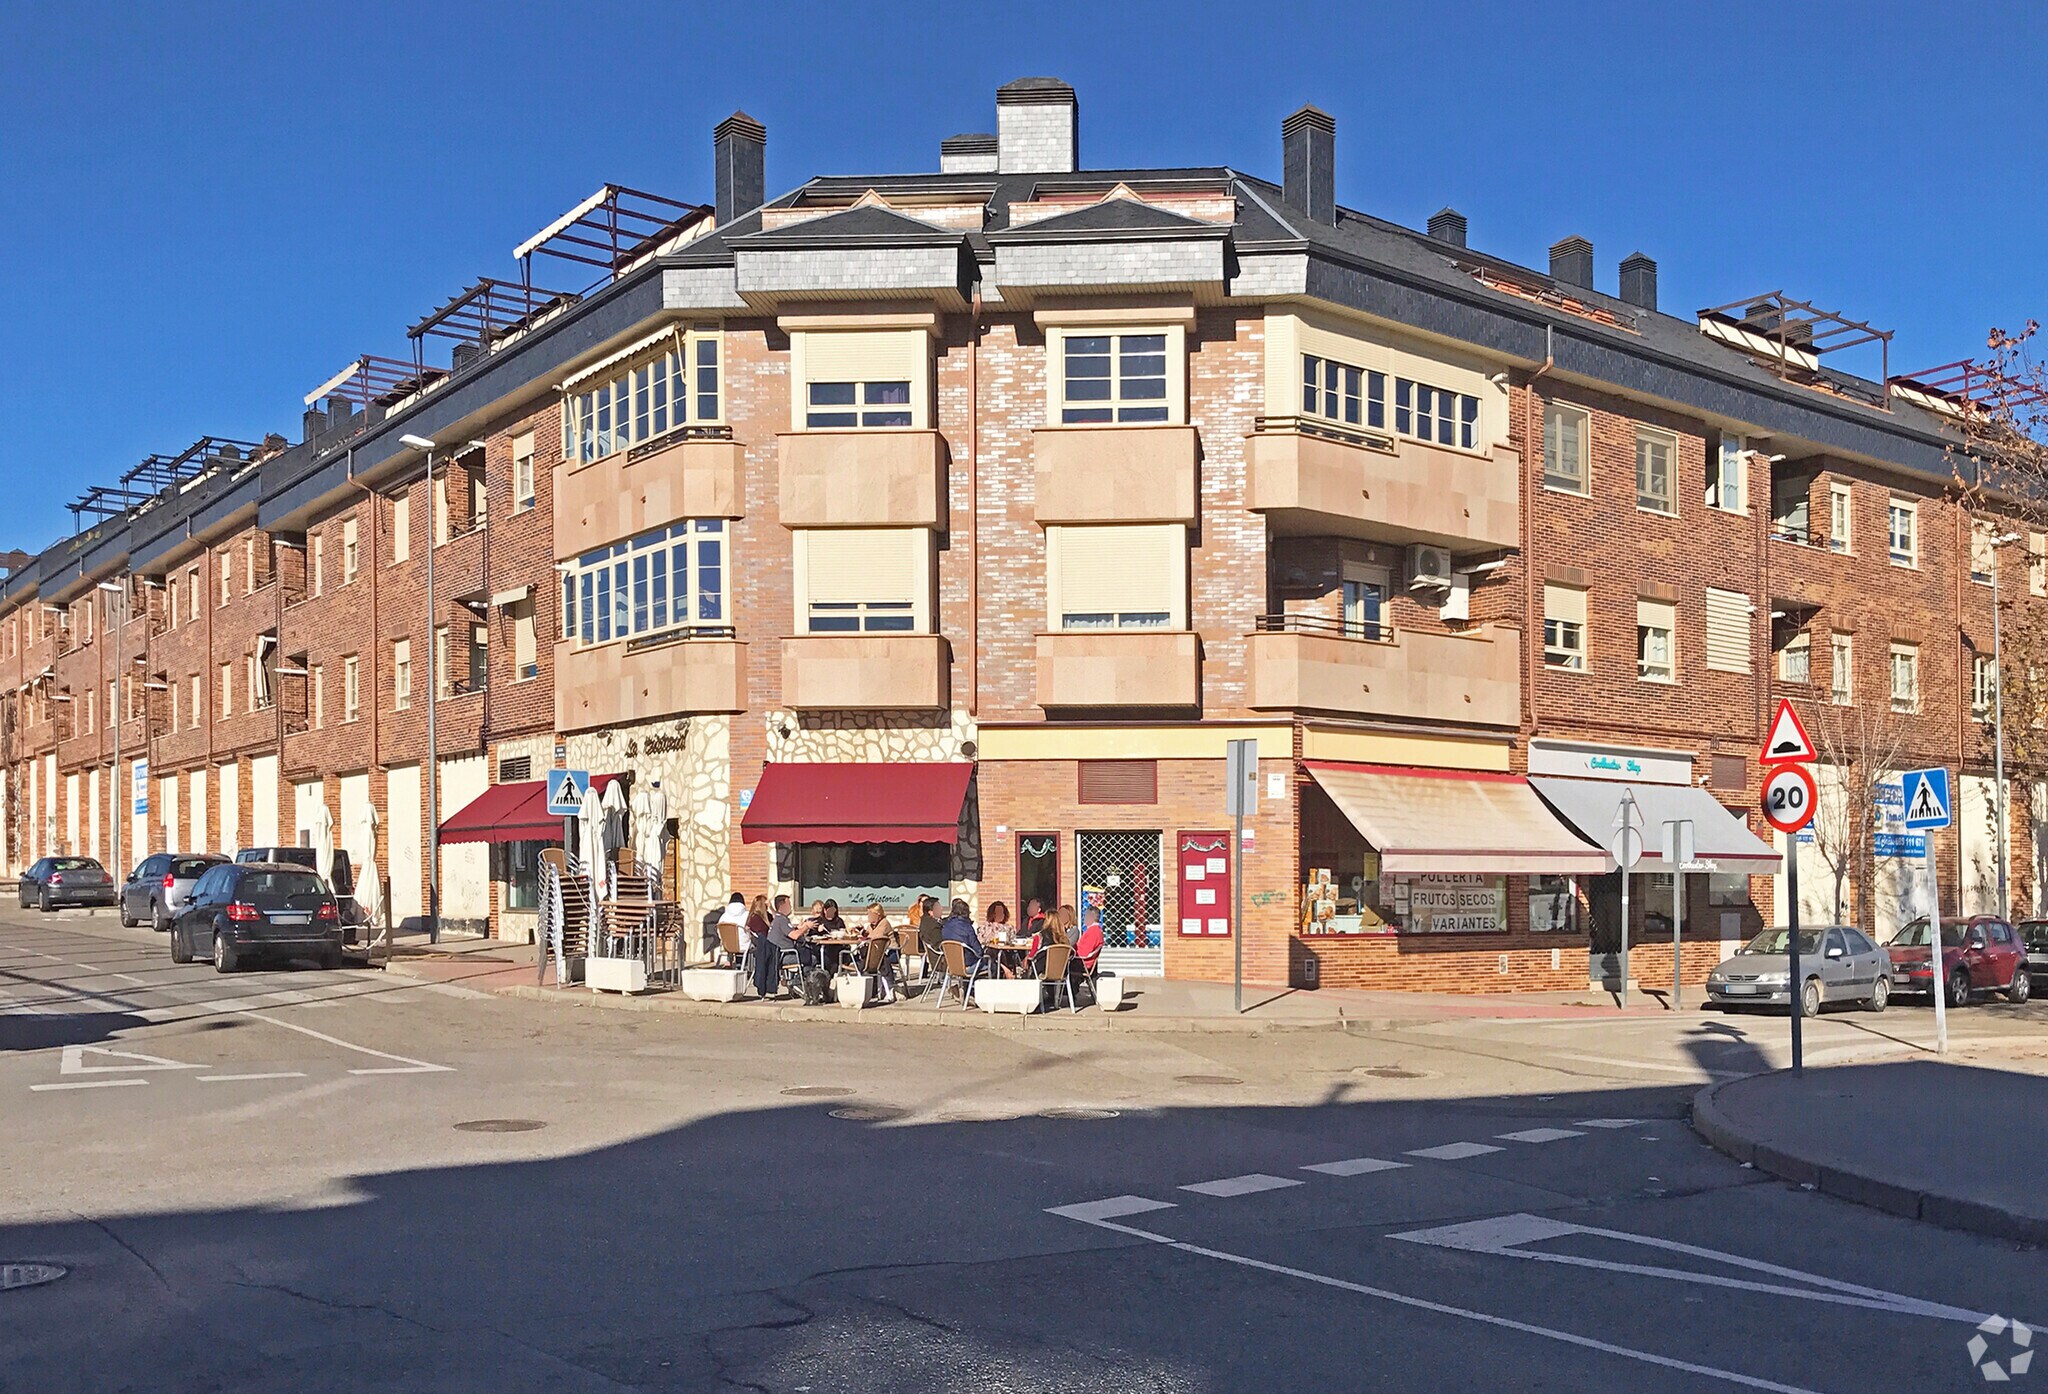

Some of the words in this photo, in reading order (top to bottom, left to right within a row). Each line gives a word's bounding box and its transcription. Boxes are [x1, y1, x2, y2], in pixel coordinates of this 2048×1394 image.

[1772, 786, 1804, 810] 20
[1413, 892, 1456, 906] FRUTOS
[1459, 893, 1496, 906] SECOS
[1413, 918, 1421, 930] Y
[1432, 917, 1496, 930] VARIANTES
